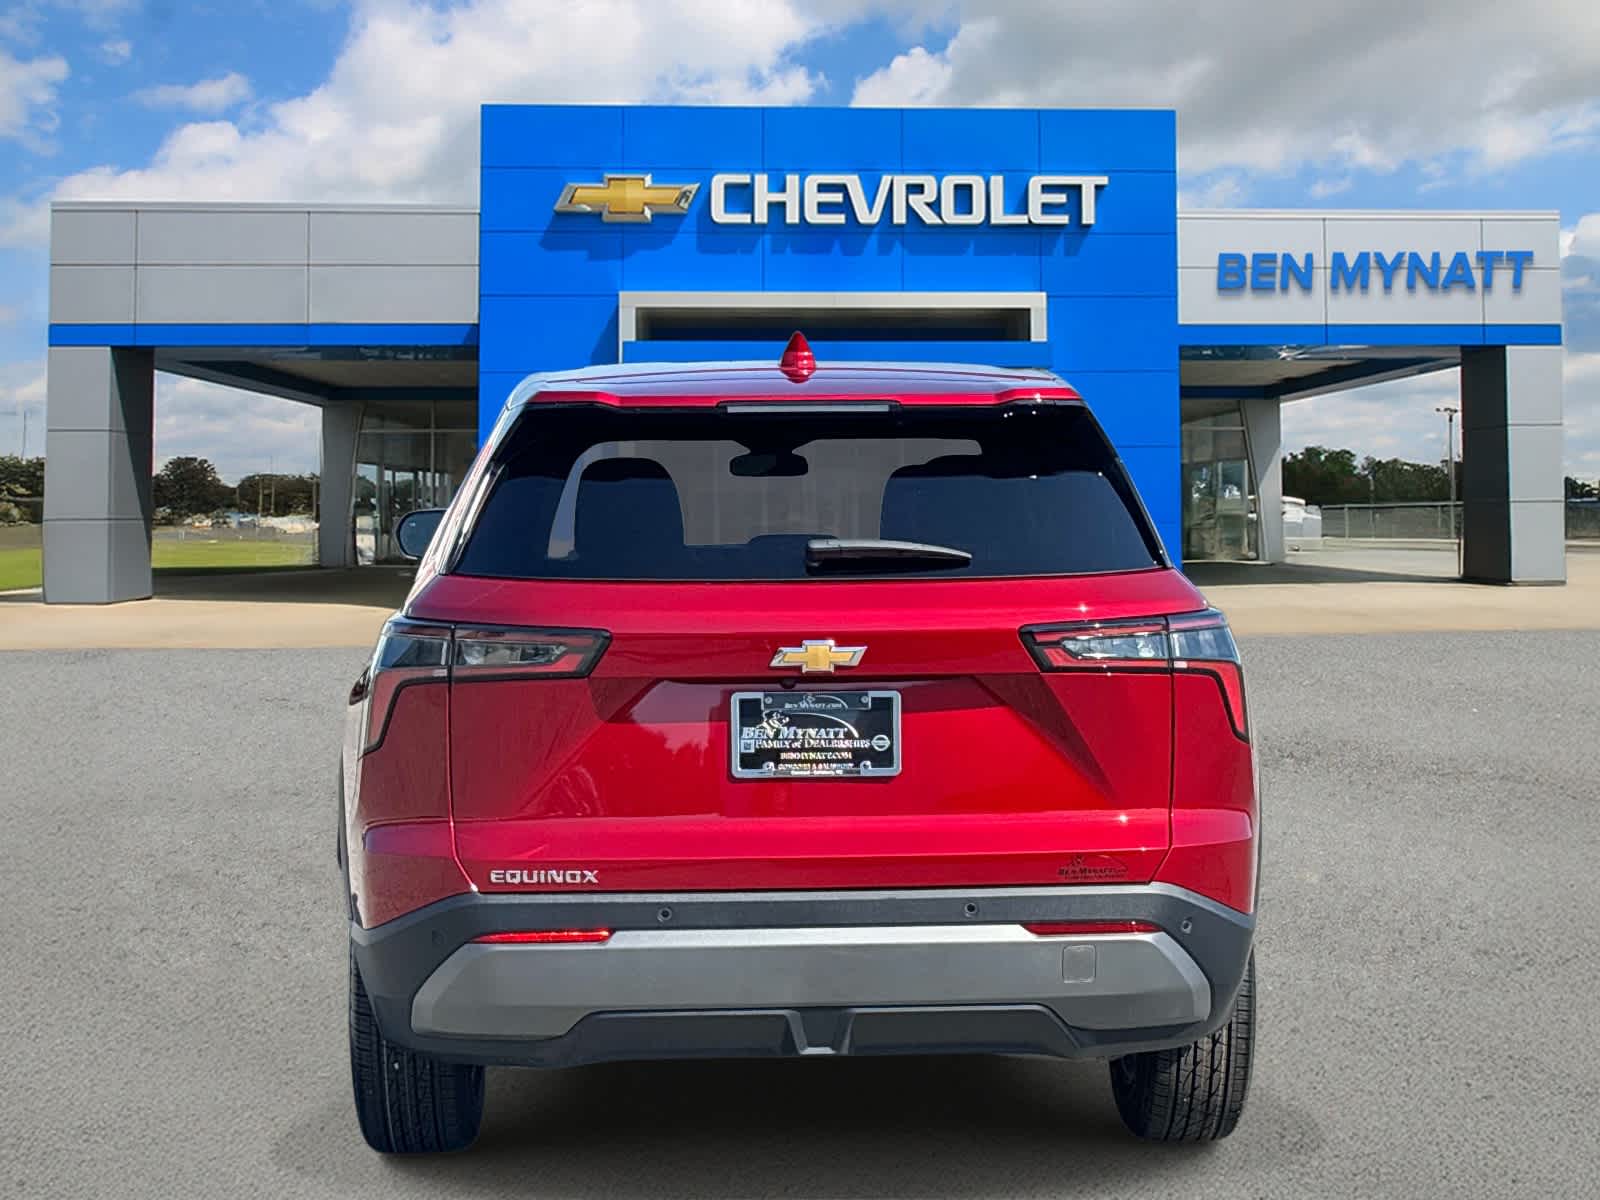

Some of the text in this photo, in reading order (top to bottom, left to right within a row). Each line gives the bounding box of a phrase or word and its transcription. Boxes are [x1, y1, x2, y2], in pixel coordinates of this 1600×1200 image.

[710, 173, 1109, 226] CHEVROLET
[1216, 250, 1534, 291] BEN MYNATT
[779, 726, 848, 739] MYNATT
[490, 869, 599, 884] EQUINOX
